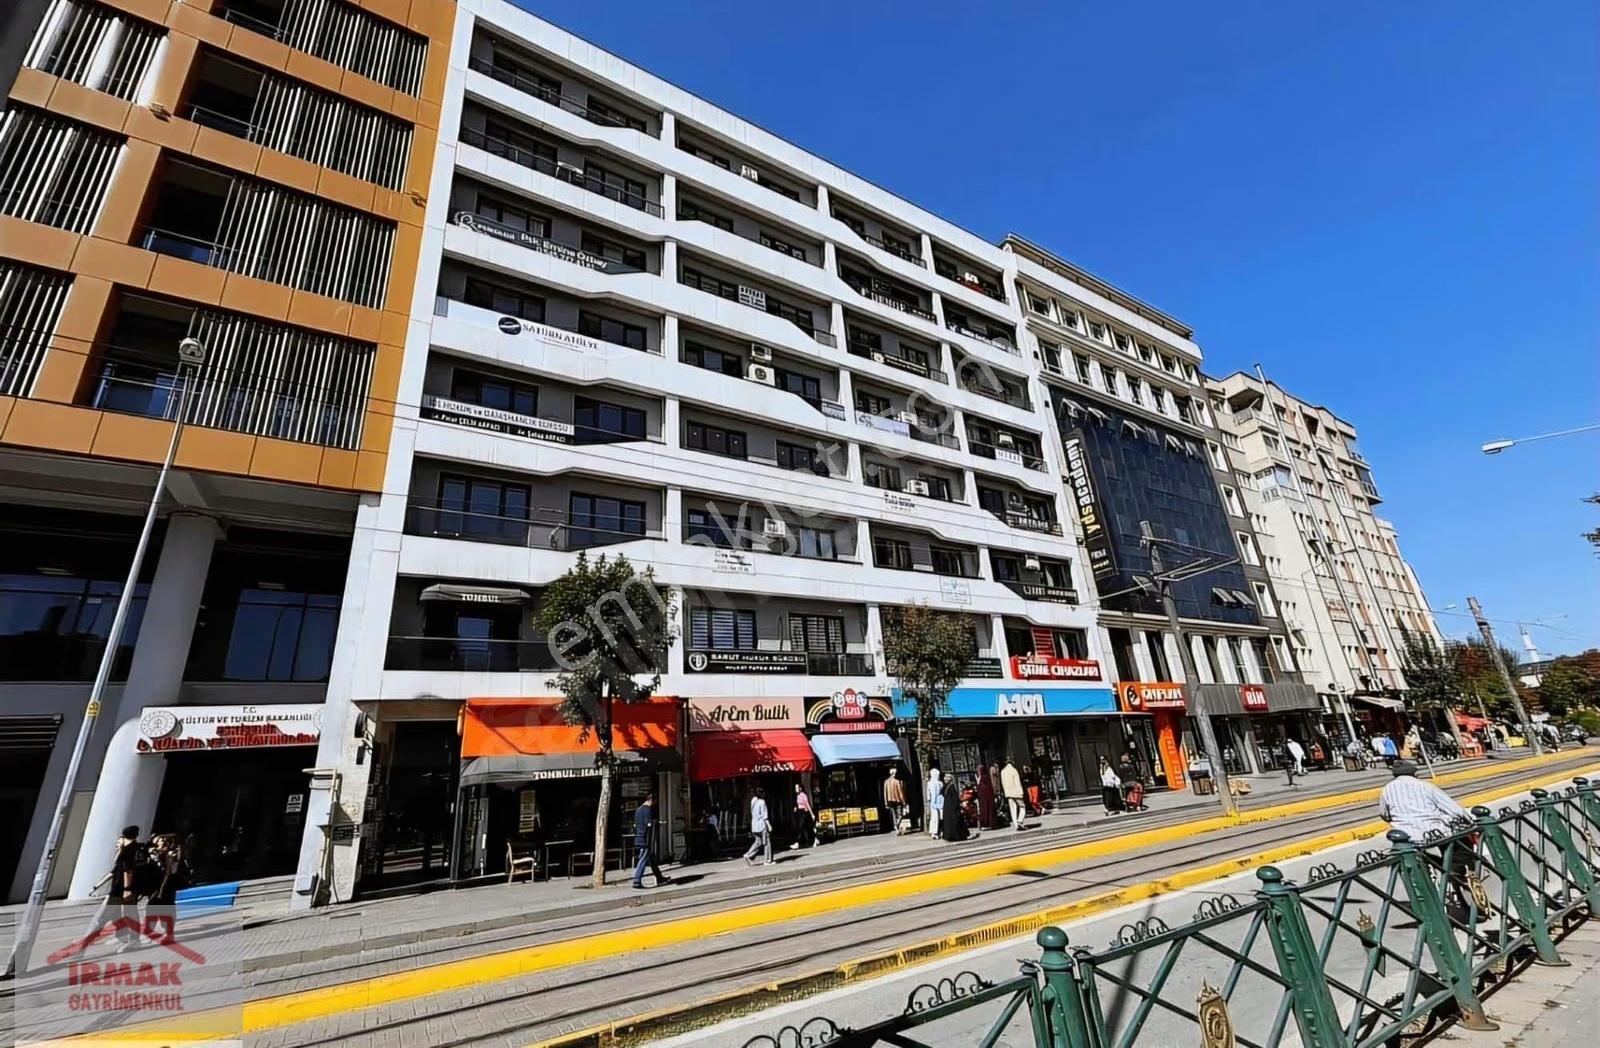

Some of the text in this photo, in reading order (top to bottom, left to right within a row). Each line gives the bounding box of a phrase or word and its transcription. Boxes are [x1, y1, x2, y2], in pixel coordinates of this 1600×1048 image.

[461, 593, 502, 603] TOMBUL
[709, 704, 750, 723] ArEm
[216, 715, 229, 724] VE
[533, 769, 576, 780] TOMBUL
